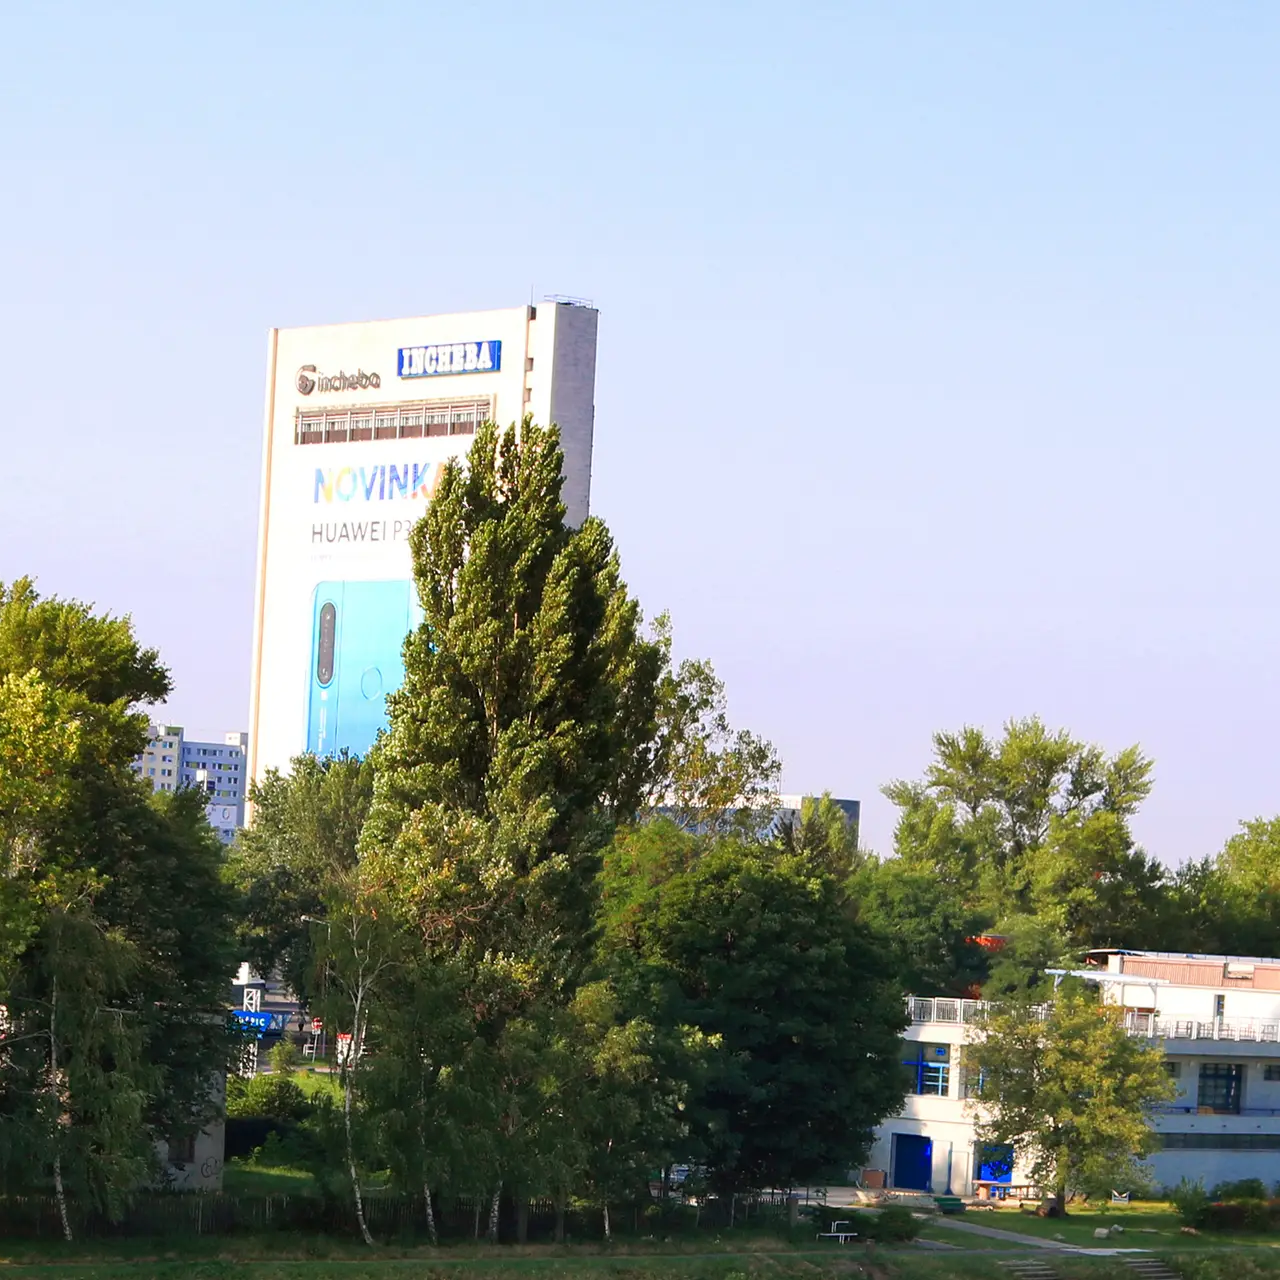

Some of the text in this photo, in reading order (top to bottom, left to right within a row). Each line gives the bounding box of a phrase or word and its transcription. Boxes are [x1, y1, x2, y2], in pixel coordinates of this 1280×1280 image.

[402, 341, 492, 375] INCHEBA
[318, 368, 381, 392] incheba
[311, 520, 386, 544] HUAWEI
